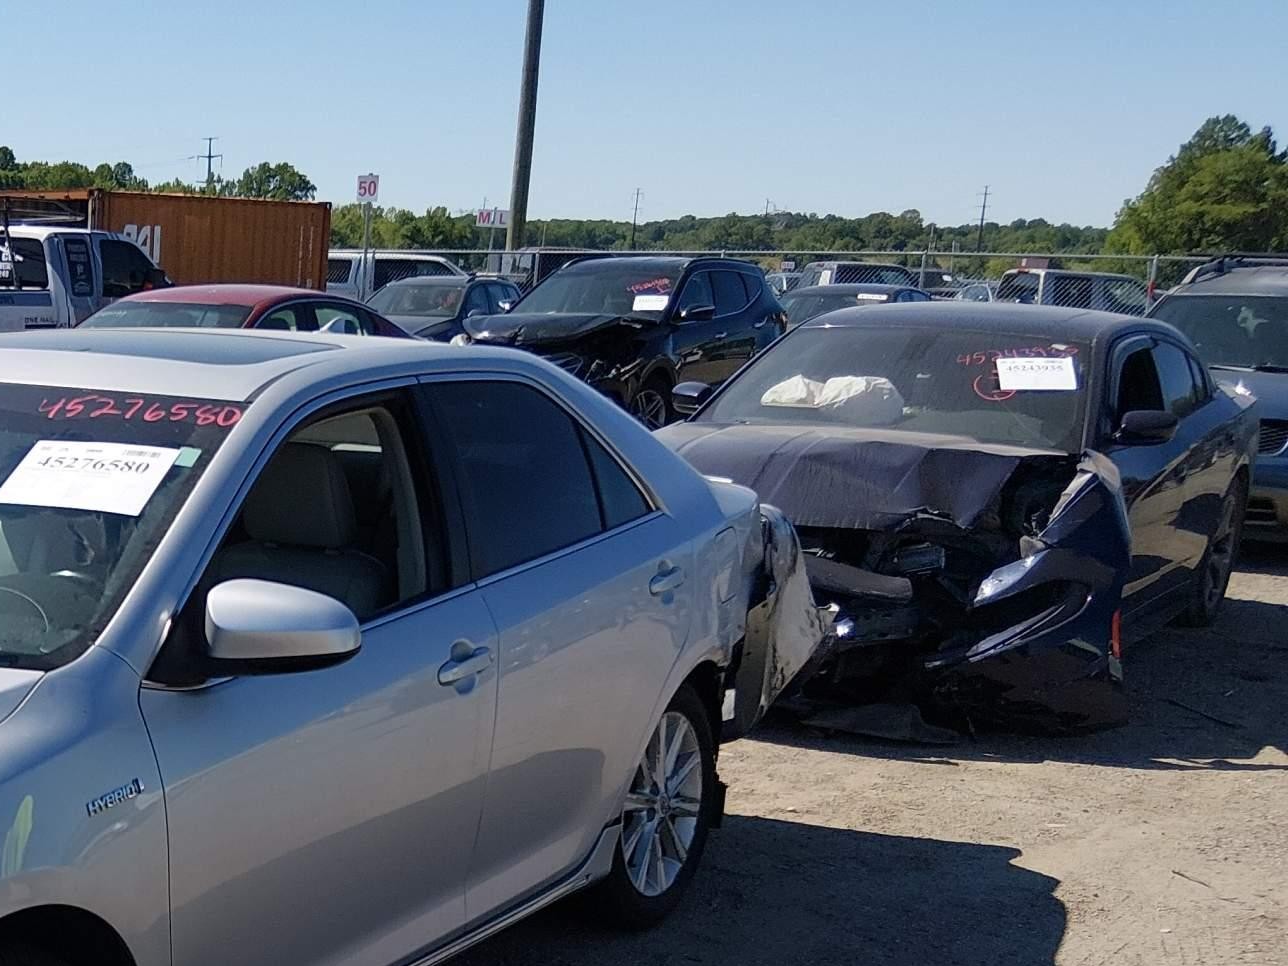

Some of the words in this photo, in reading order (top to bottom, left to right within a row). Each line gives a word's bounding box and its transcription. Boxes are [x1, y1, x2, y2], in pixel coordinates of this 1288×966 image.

[358, 180, 377, 197] 50
[38, 395, 241, 427] 45276580
[38, 455, 150, 474] 45276580
[86, 780, 138, 817] HYBRID
